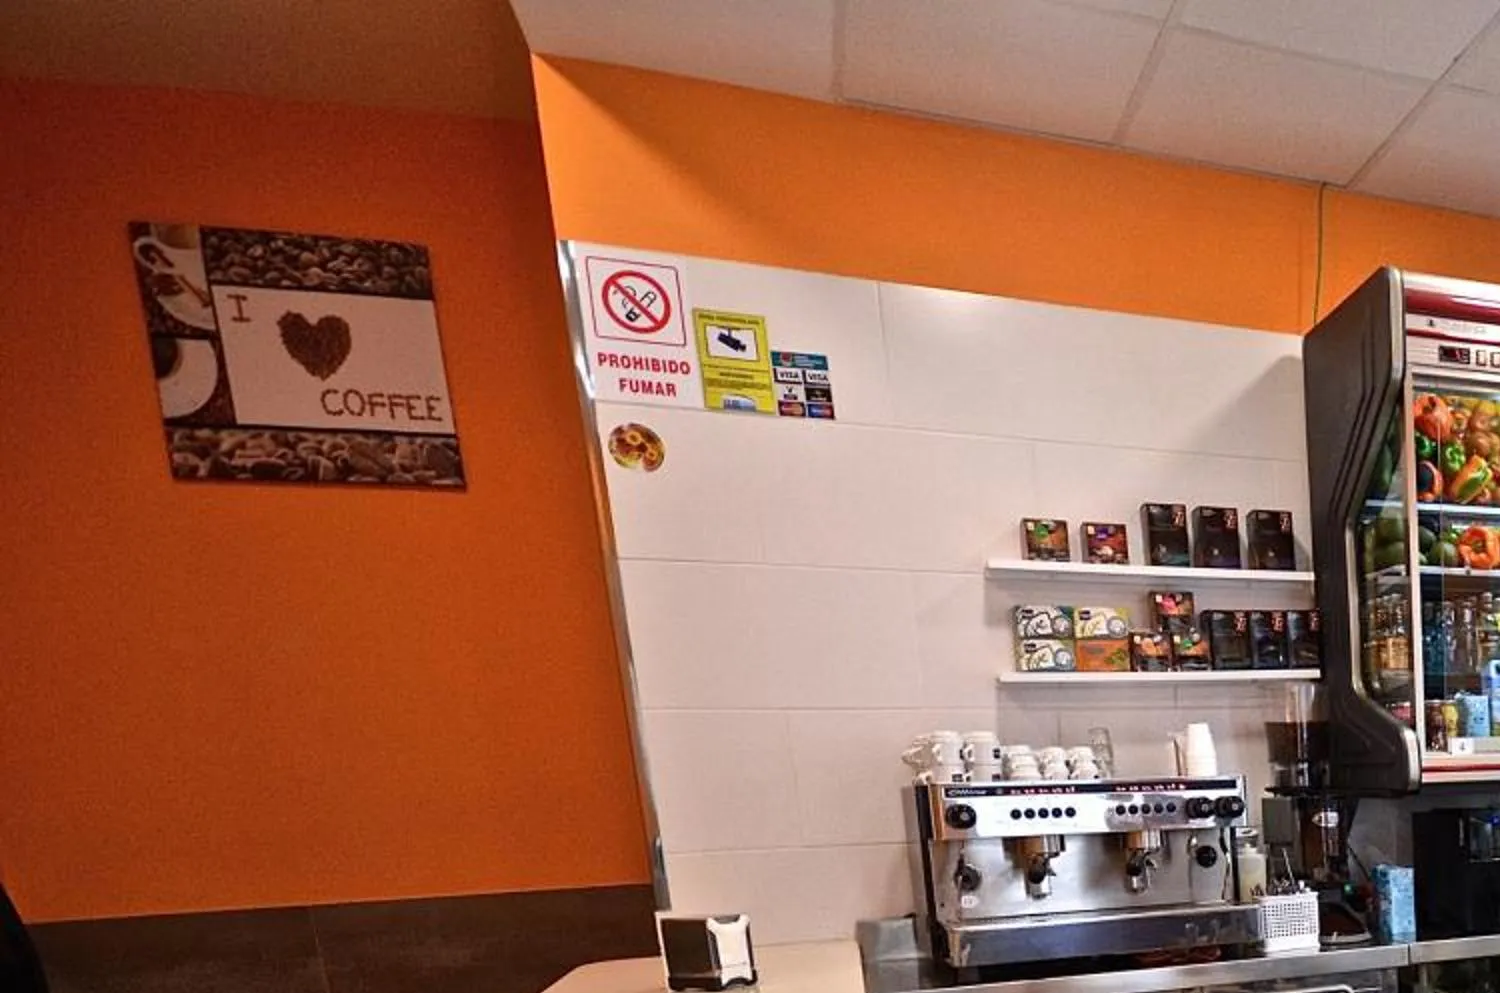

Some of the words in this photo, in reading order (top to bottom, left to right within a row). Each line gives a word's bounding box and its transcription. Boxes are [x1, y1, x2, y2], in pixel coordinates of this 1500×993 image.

[227, 293, 251, 323] I
[597, 352, 690, 375] PROHIBIDO
[619, 378, 677, 398] FUMAR
[319, 388, 443, 421] COFFEE
